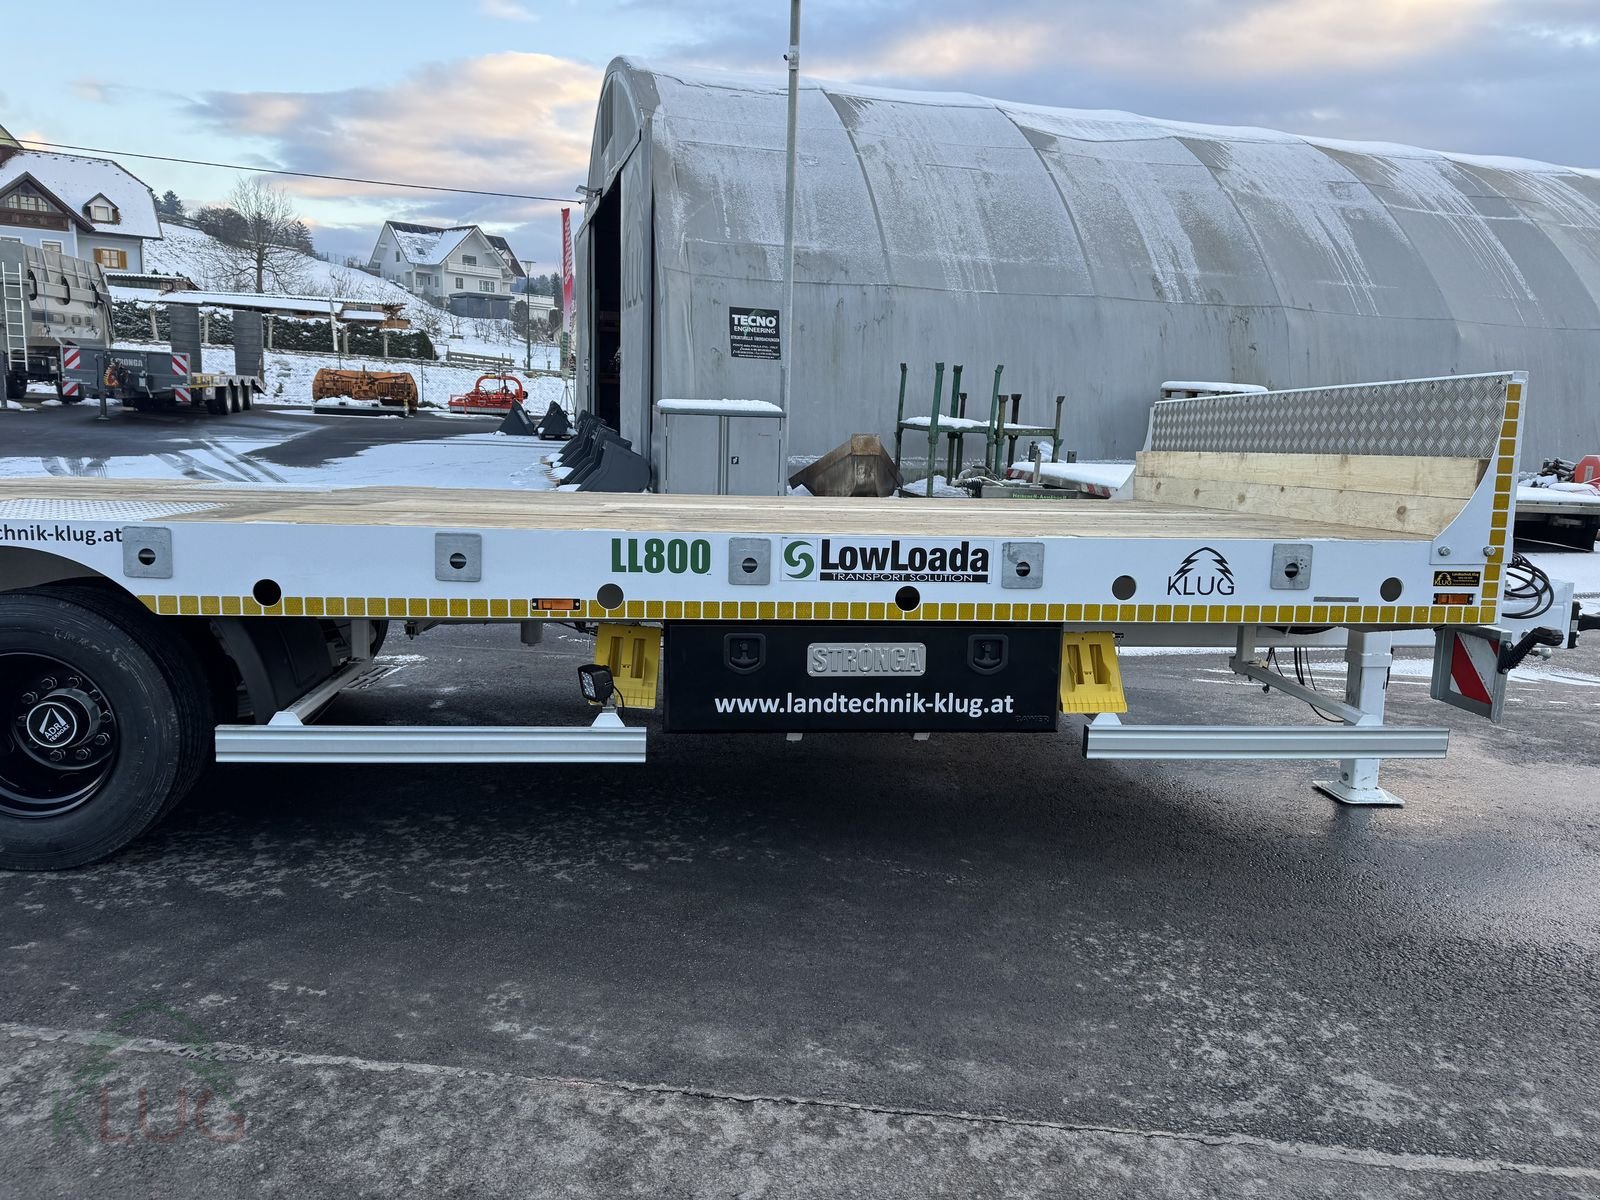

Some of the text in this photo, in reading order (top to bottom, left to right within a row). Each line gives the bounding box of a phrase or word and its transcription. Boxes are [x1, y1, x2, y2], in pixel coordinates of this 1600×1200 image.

[731, 314, 777, 328] TECNO
[733, 325, 776, 334] ENGINEERING
[611, 538, 711, 574] LL800
[820, 539, 990, 573] LowLoada
[831, 572, 973, 583] TRANSPORT SOLUTION
[1167, 575, 1235, 596] KLUG
[812, 646, 922, 673] STRONGA
[714, 692, 1014, 718] www.landtechnik-klug.at
[44, 722, 62, 739] ADR
